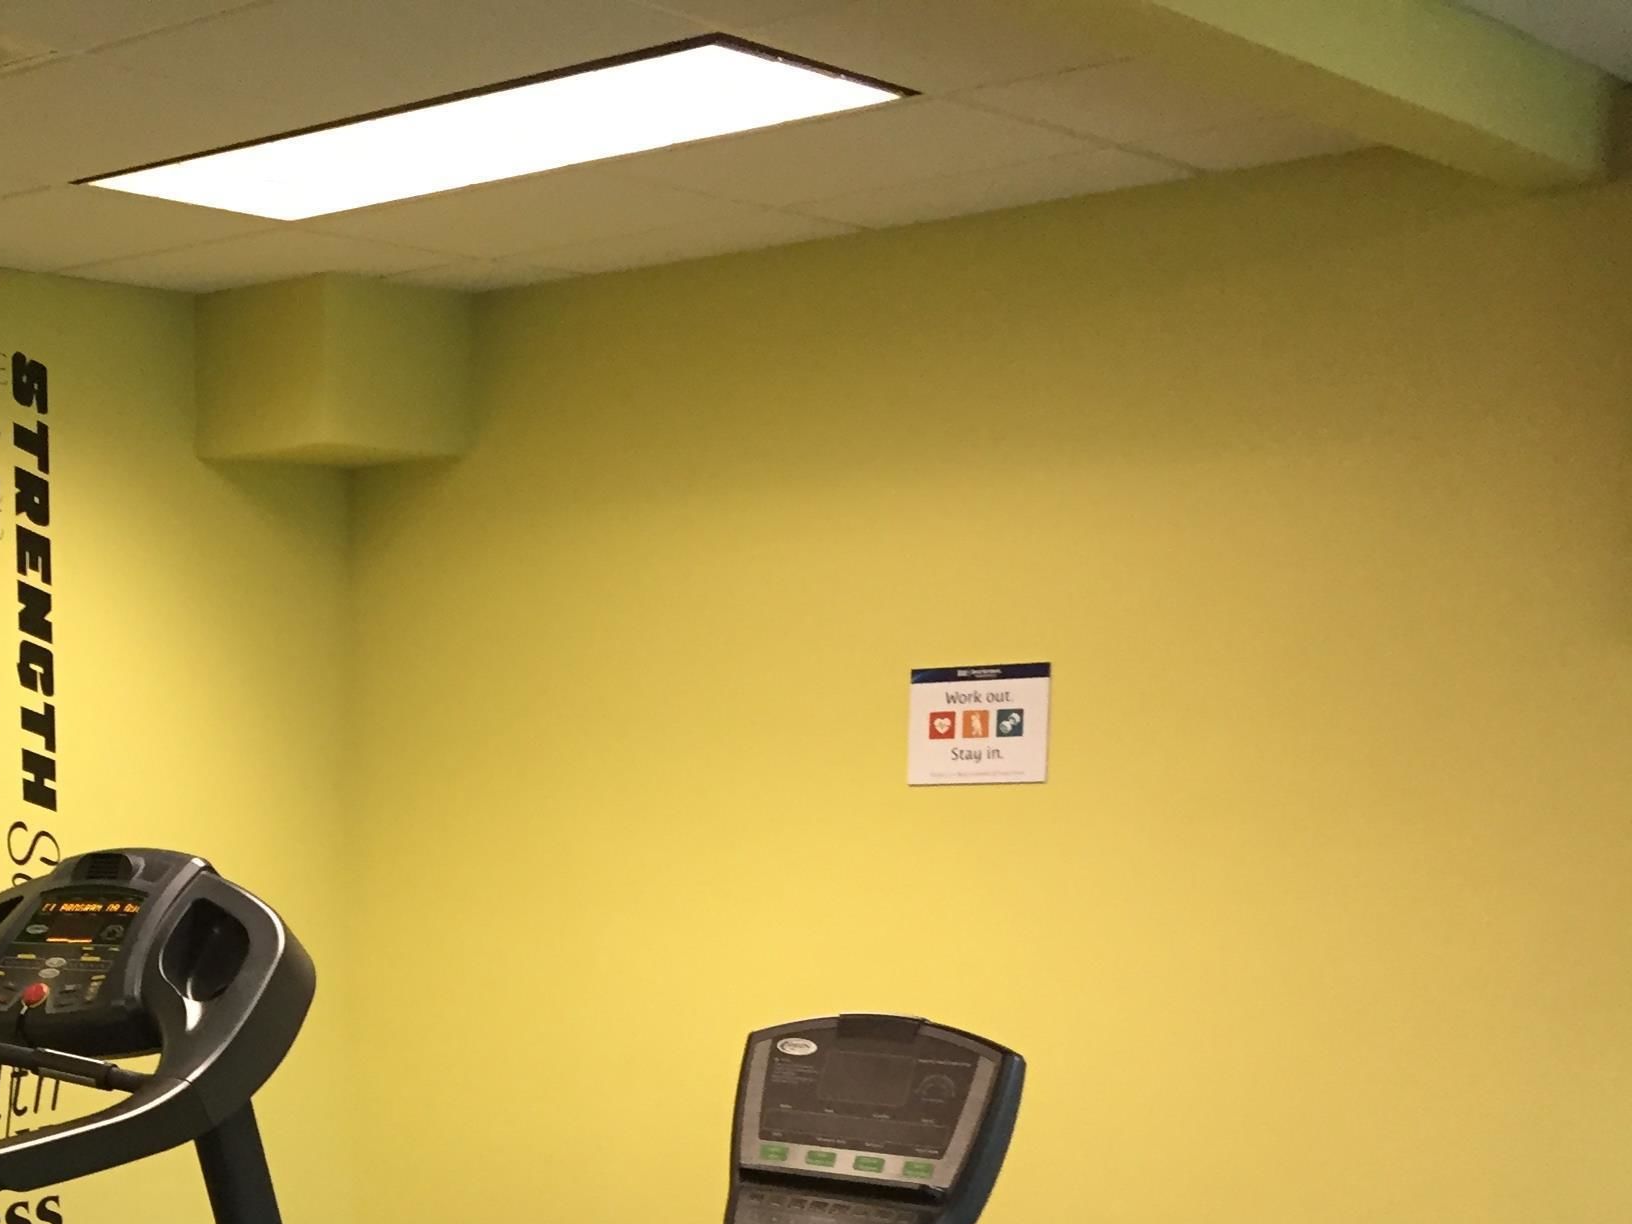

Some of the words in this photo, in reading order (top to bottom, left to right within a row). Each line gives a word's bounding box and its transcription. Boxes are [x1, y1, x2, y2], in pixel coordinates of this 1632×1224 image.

[11, 351, 57, 812] STRENGTH
[945, 690, 982, 704] Work
[951, 747, 982, 763] Stay
